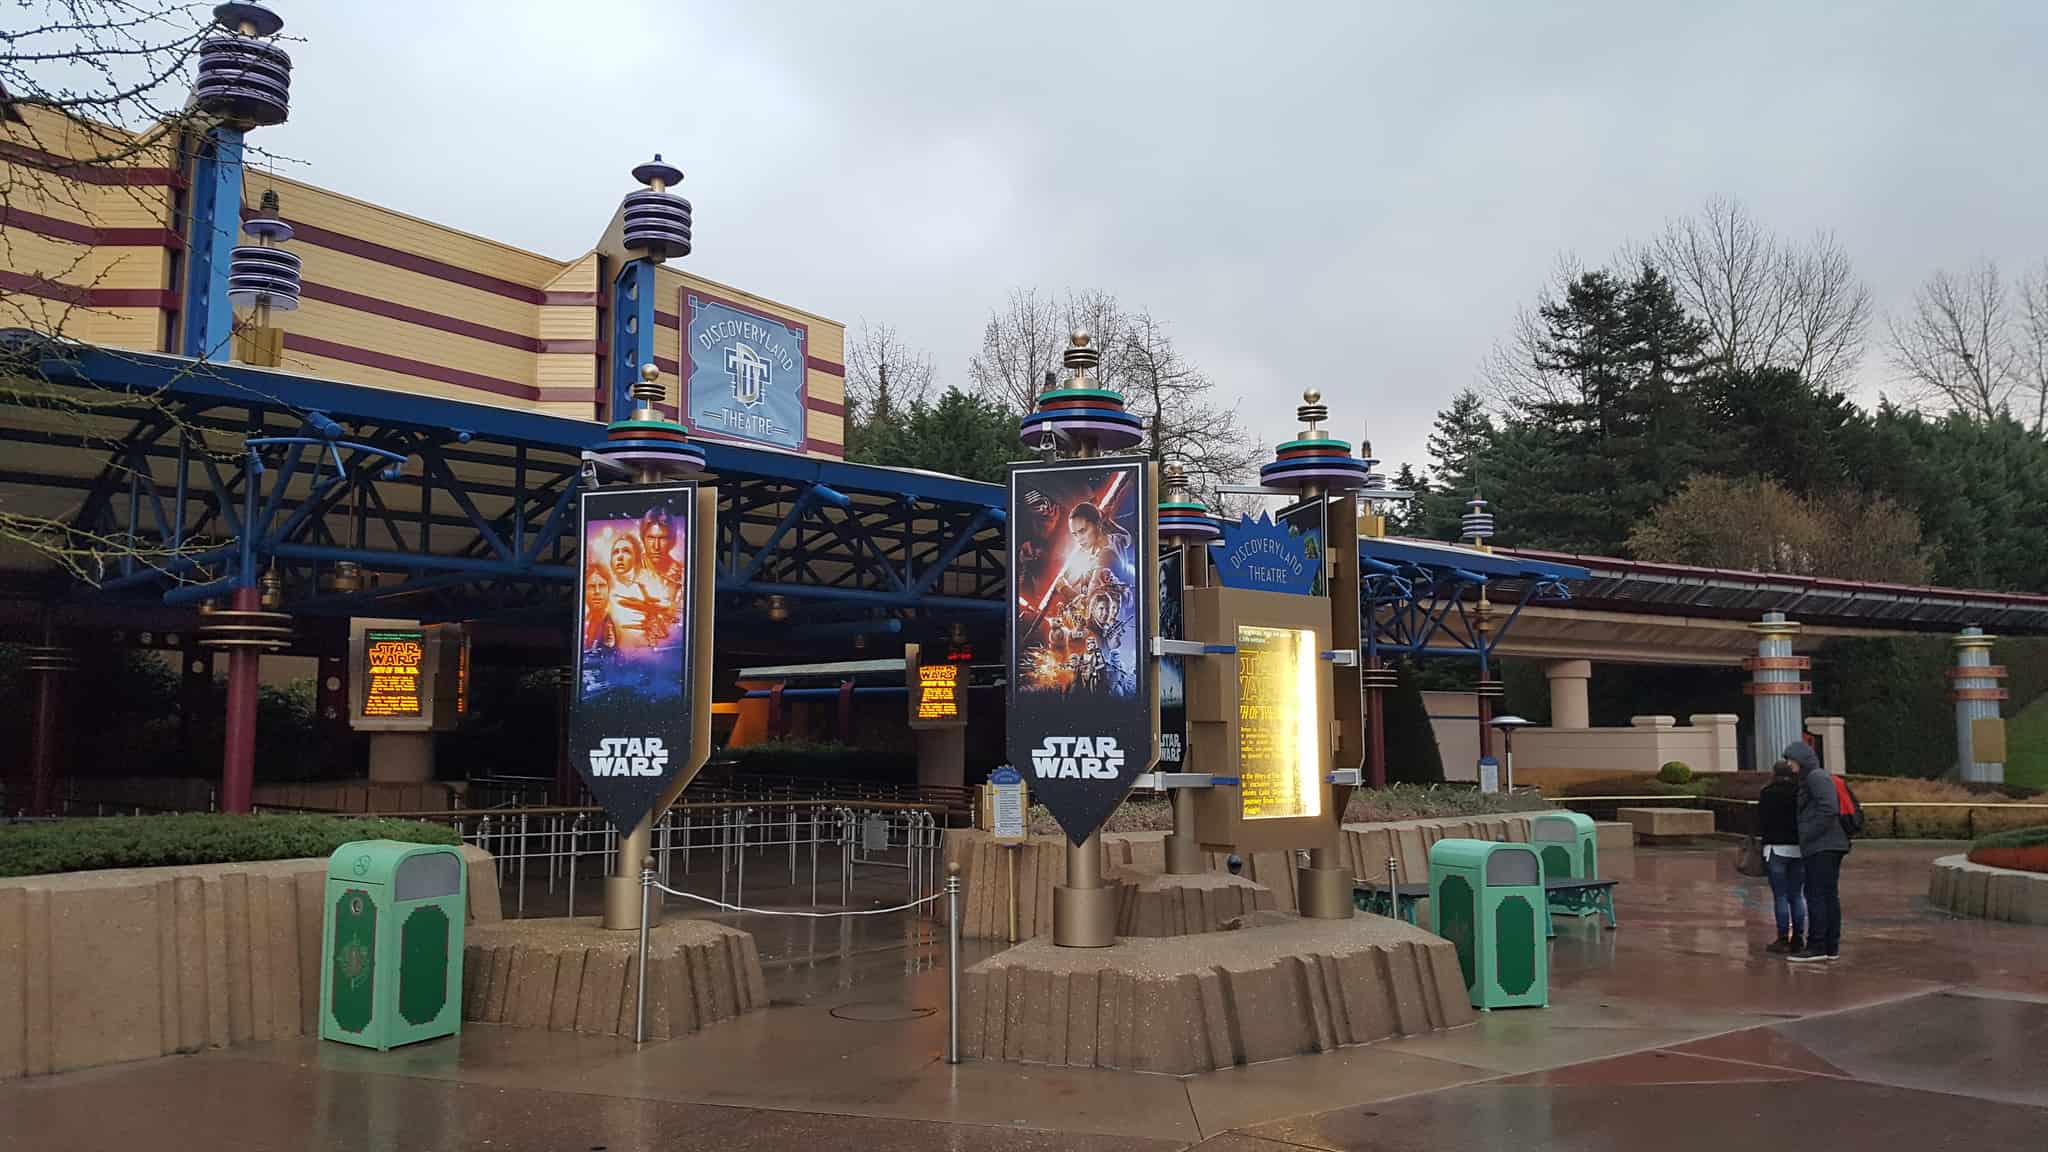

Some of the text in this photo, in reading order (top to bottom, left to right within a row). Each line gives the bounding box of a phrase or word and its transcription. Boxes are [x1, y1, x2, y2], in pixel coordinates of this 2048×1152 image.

[699, 320, 793, 371] DISCOVERYLAND
[721, 408, 772, 435] THEATRE
[1230, 537, 1304, 576] DISCOVERYLAND
[1248, 565, 1289, 584] THEATRE
[369, 642, 421, 655] STAR
[370, 654, 421, 666] WARS
[590, 737, 669, 757] STAR
[1032, 737, 1125, 758] STAR
[1160, 733, 1181, 747] STAR
[1160, 747, 1181, 762] WARS
[590, 757, 669, 777] WARS
[1032, 758, 1125, 779] WARS
